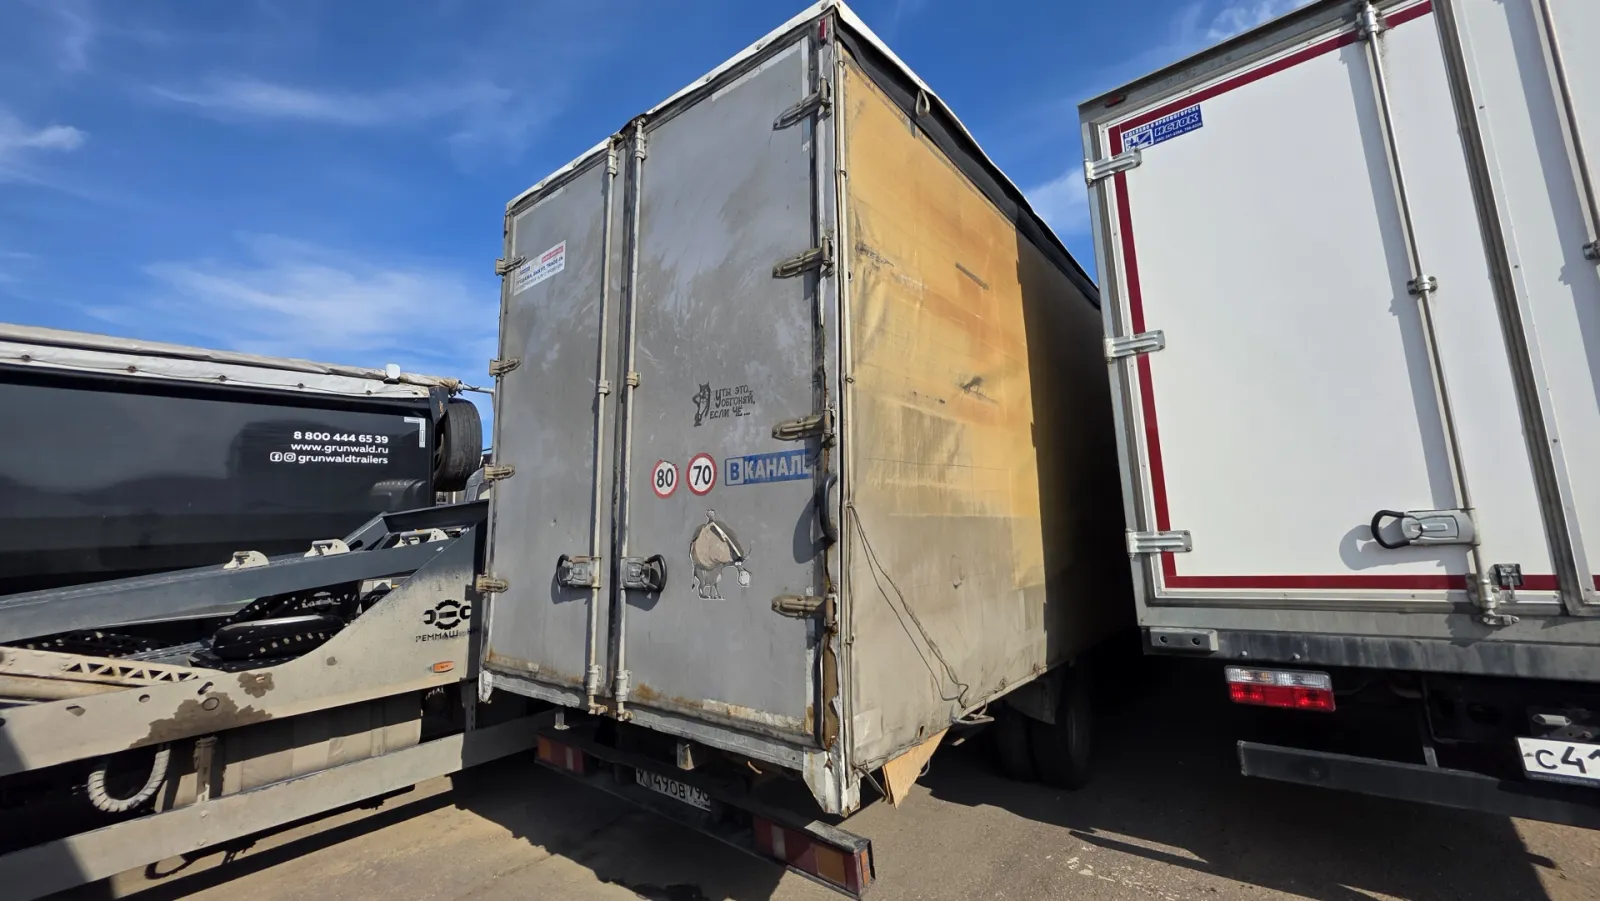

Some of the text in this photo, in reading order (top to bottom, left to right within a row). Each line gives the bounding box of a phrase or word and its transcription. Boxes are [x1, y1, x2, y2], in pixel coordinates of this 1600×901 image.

[1154, 112, 1199, 137] ИСТОК
[709, 408, 730, 420] ЕСЛИ
[293, 430, 389, 444] 8 800 444 65 39
[291, 443, 389, 454] www.grunwald.ru
[298, 454, 389, 464] grunwaldtrailers
[656, 467, 674, 488] 80
[692, 464, 712, 486] 70
